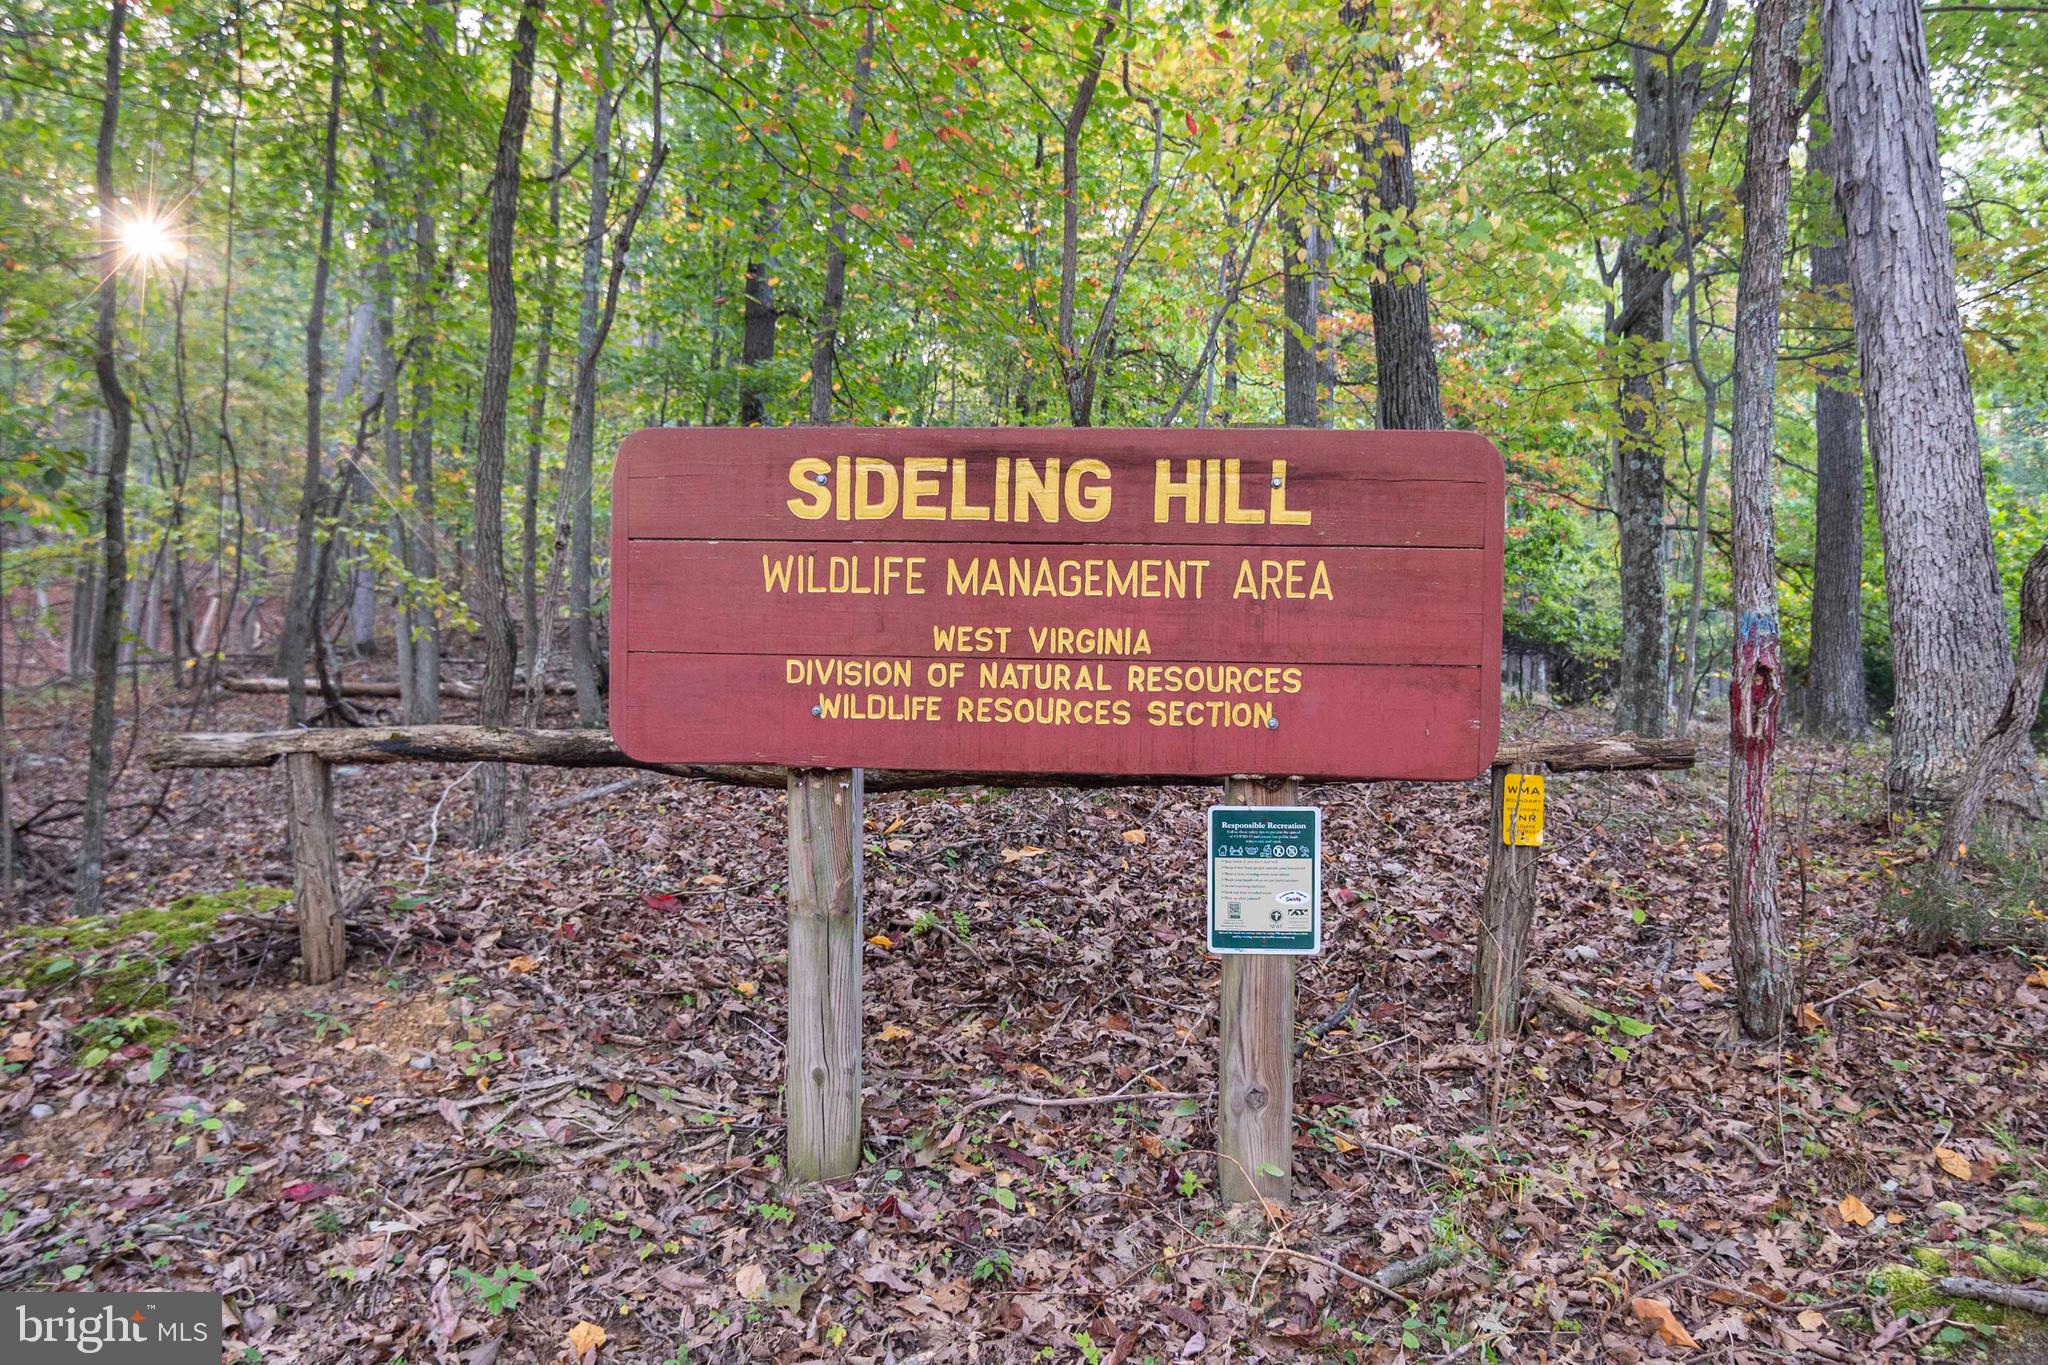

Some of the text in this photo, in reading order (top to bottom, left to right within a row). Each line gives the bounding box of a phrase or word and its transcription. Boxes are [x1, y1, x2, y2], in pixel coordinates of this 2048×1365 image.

[787, 456, 1312, 526] SIDELING HILL
[762, 554, 1333, 601] WILDLIFE MANAGEMENT AREA
[932, 625, 1152, 656] WEST VIRGINIA
[786, 659, 1303, 694] DIVISION OF NATURAL RESOURCES
[818, 697, 1274, 729] WILDLIFE RESOURCES SECTION
[1507, 785, 1541, 795] WMA
[1221, 821, 1307, 830] Responsible Recreation
[1510, 814, 1537, 822] NR
